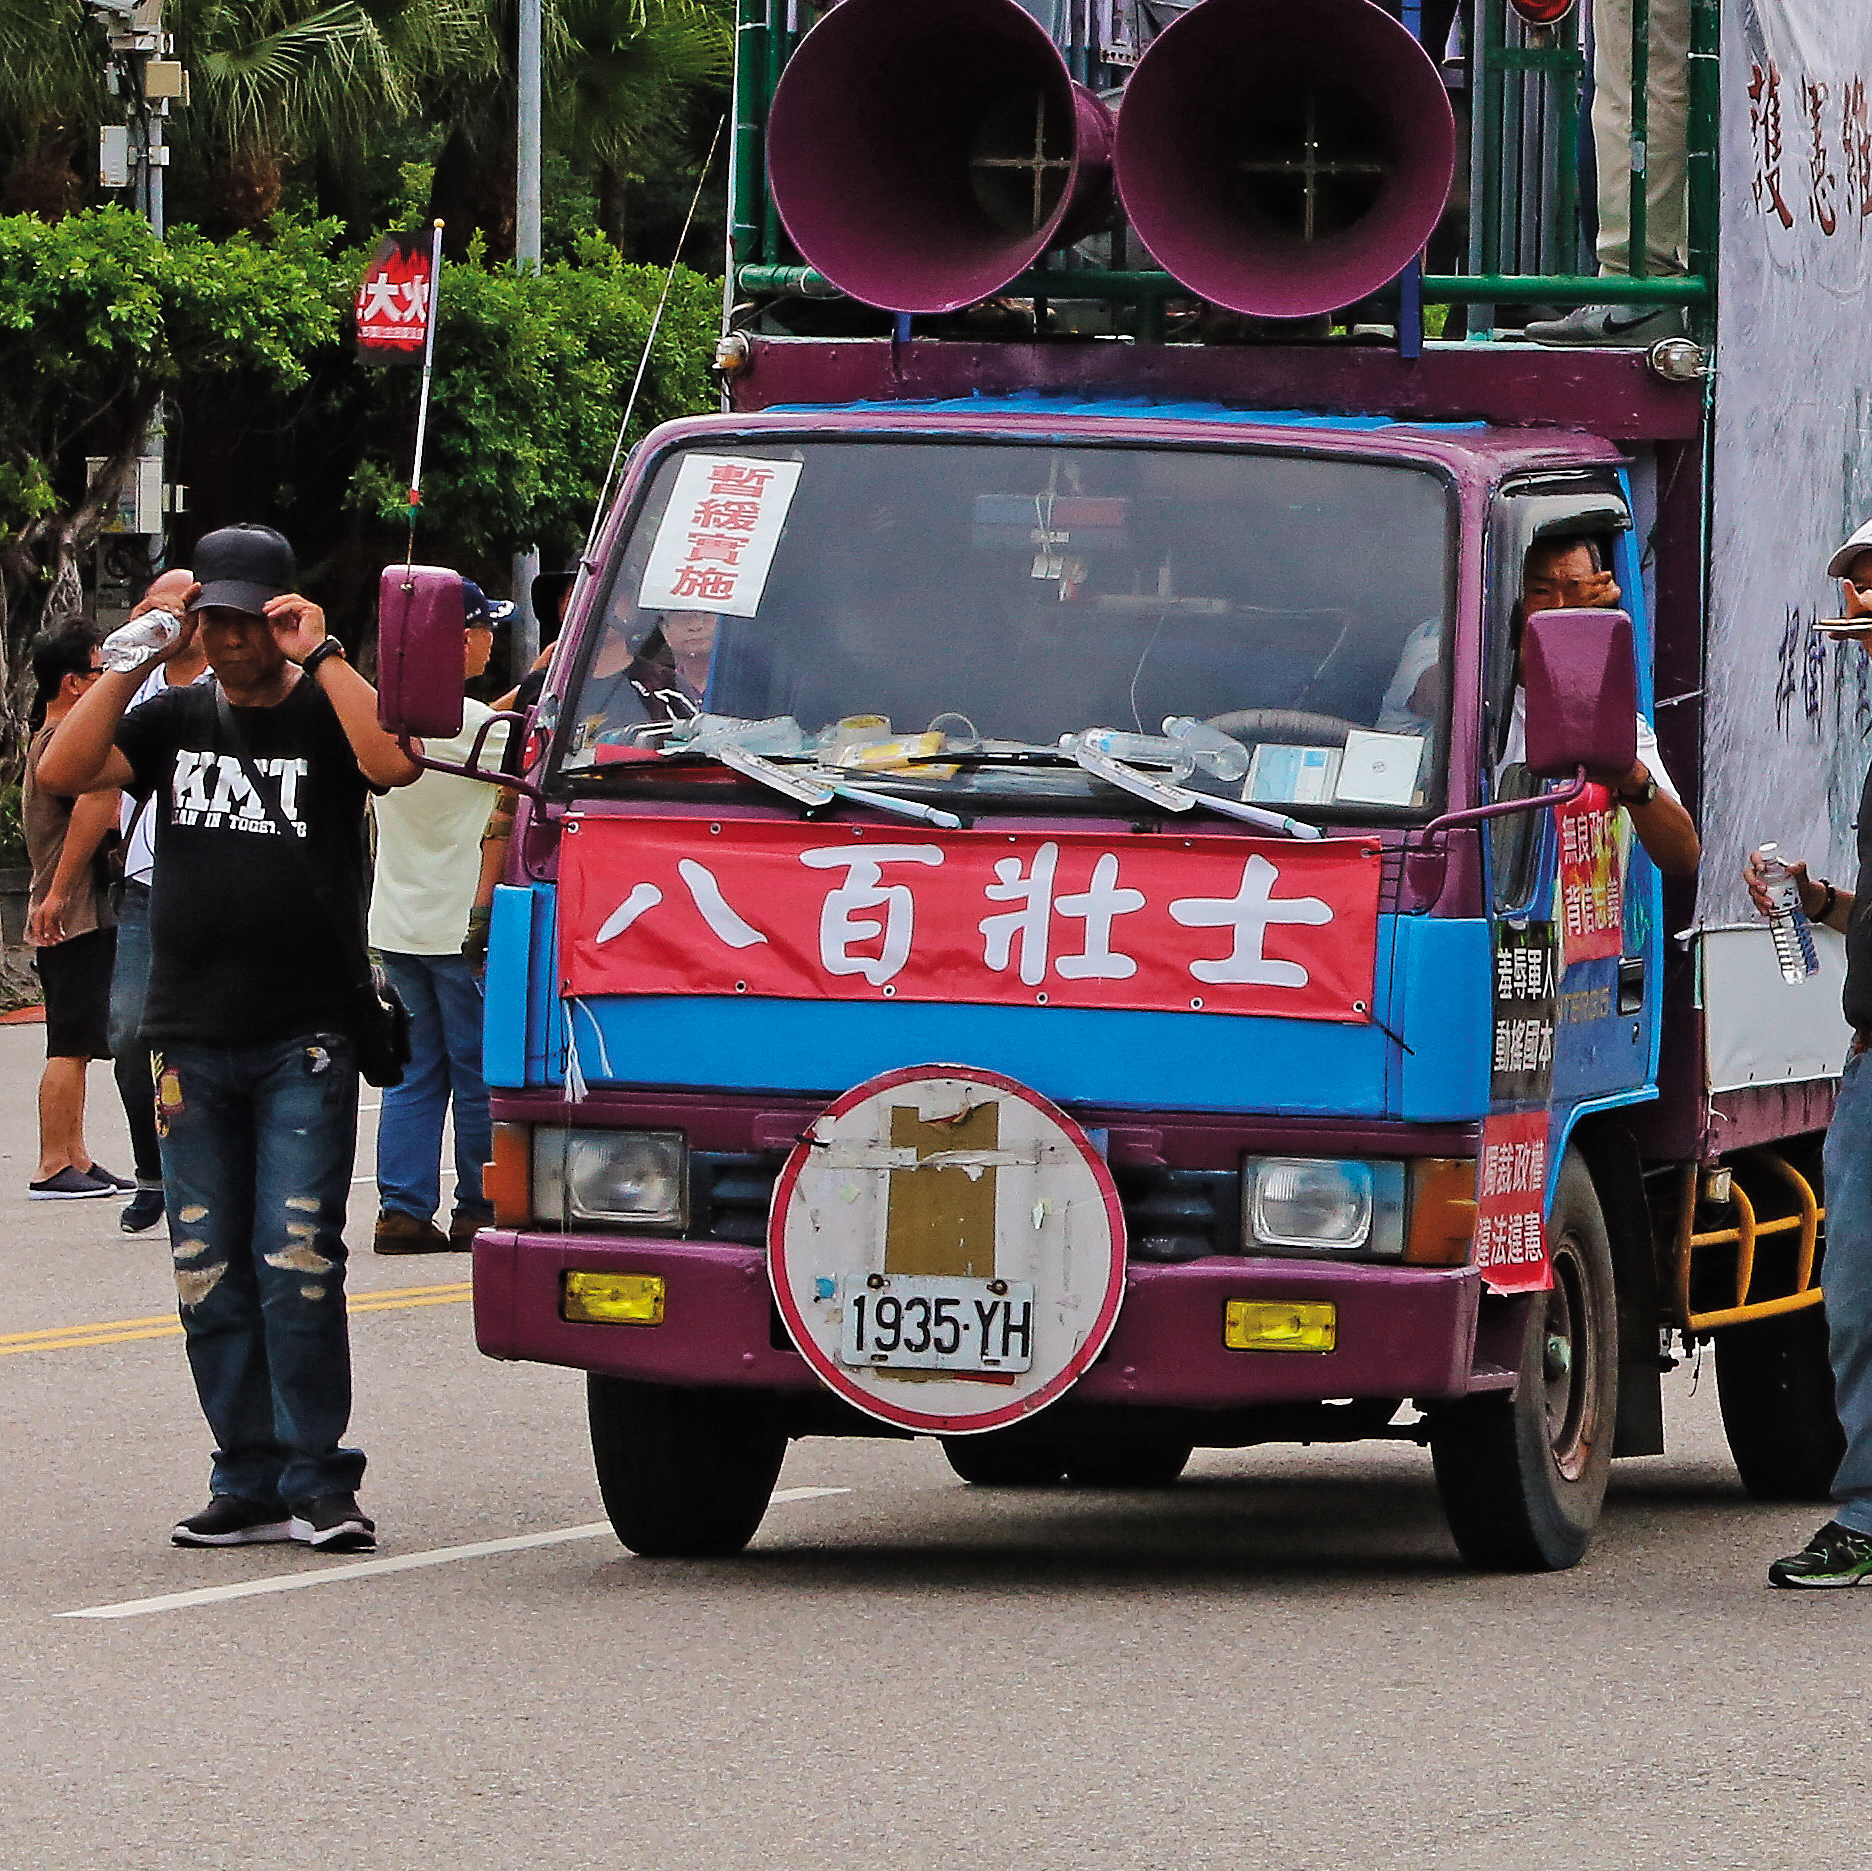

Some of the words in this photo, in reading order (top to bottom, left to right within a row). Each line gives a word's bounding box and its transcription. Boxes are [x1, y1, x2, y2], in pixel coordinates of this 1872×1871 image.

[669, 464, 776, 600] 暫緩實施
[172, 748, 308, 821] KMT
[597, 841, 1336, 990] 八百壯士
[1497, 947, 1556, 1000] 羞辱軍人
[1493, 1019, 1554, 1072] 動搖國本
